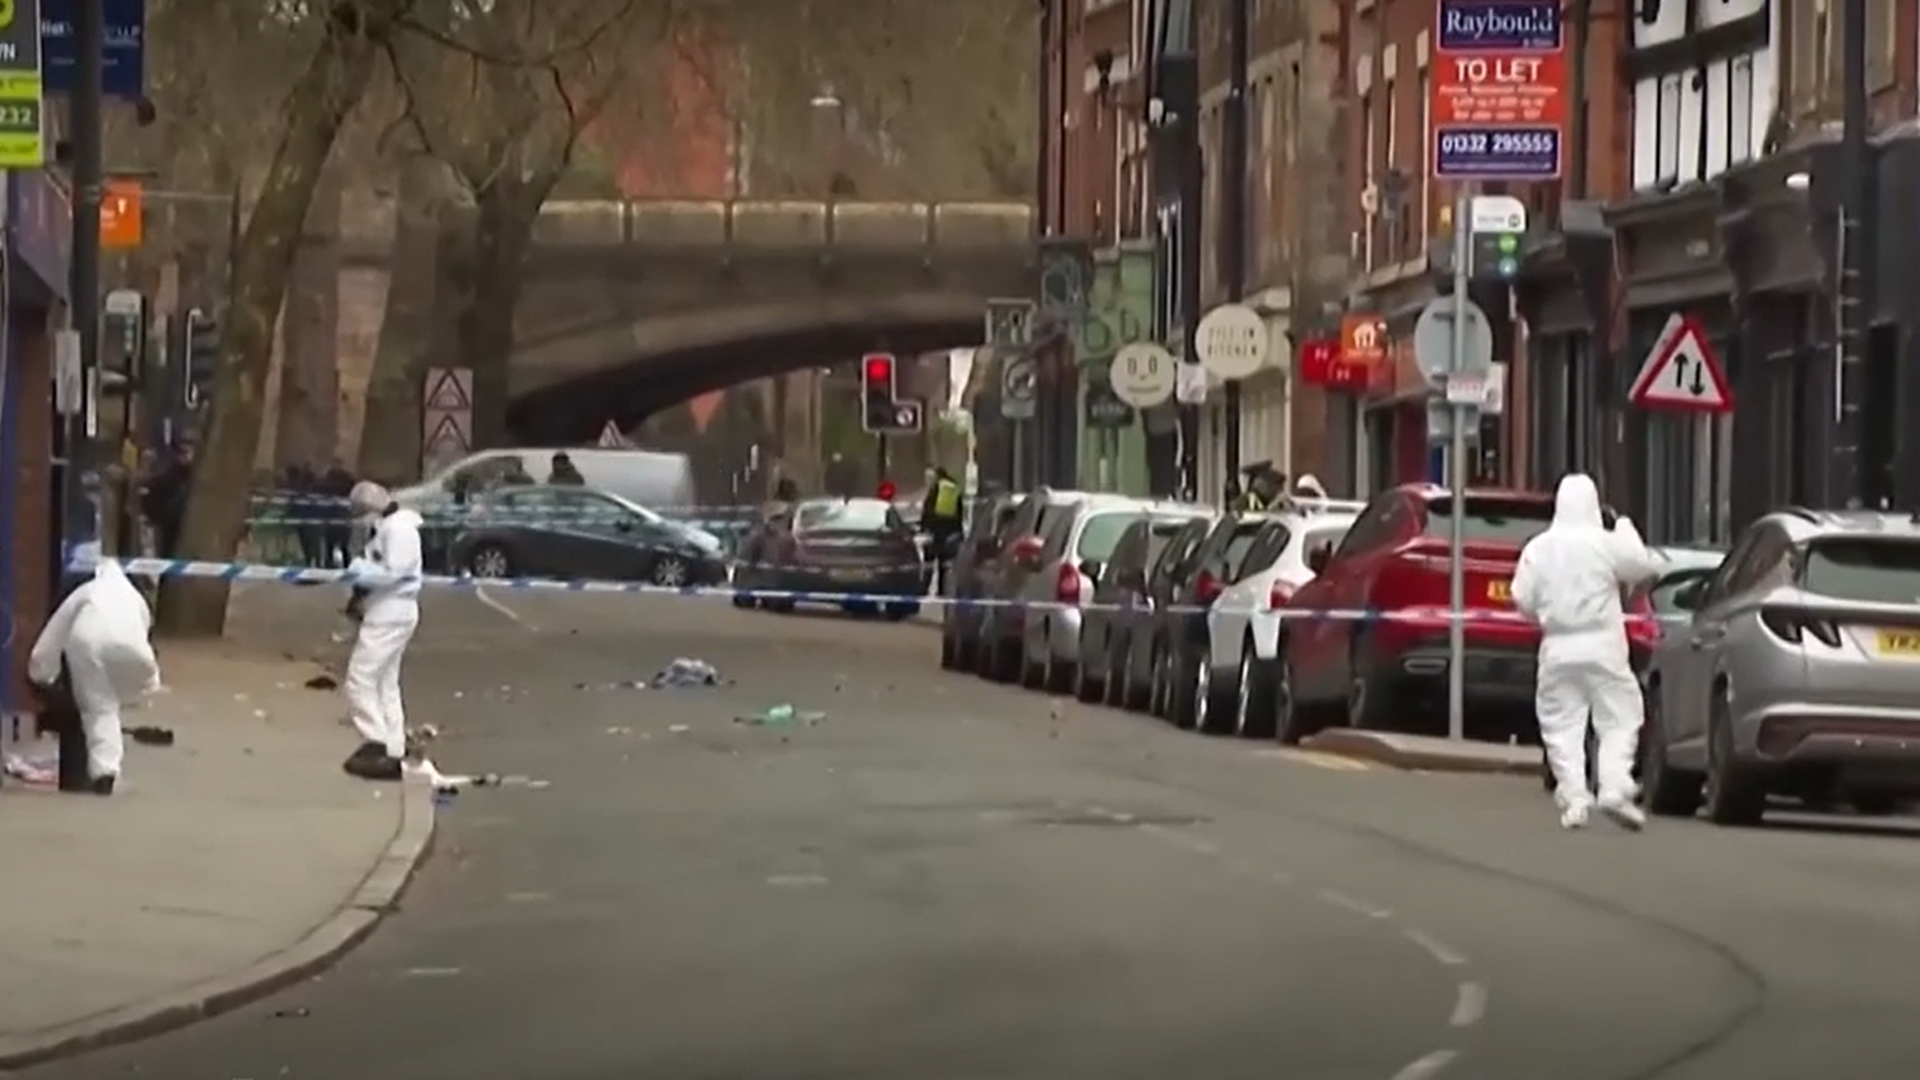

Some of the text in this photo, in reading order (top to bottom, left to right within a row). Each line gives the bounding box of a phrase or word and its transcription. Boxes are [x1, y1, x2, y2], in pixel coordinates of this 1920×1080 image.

[1446, 7, 1554, 39] Raybould
[1455, 58, 1543, 83] TO LET
[1441, 133, 1553, 154] 01332 295555
